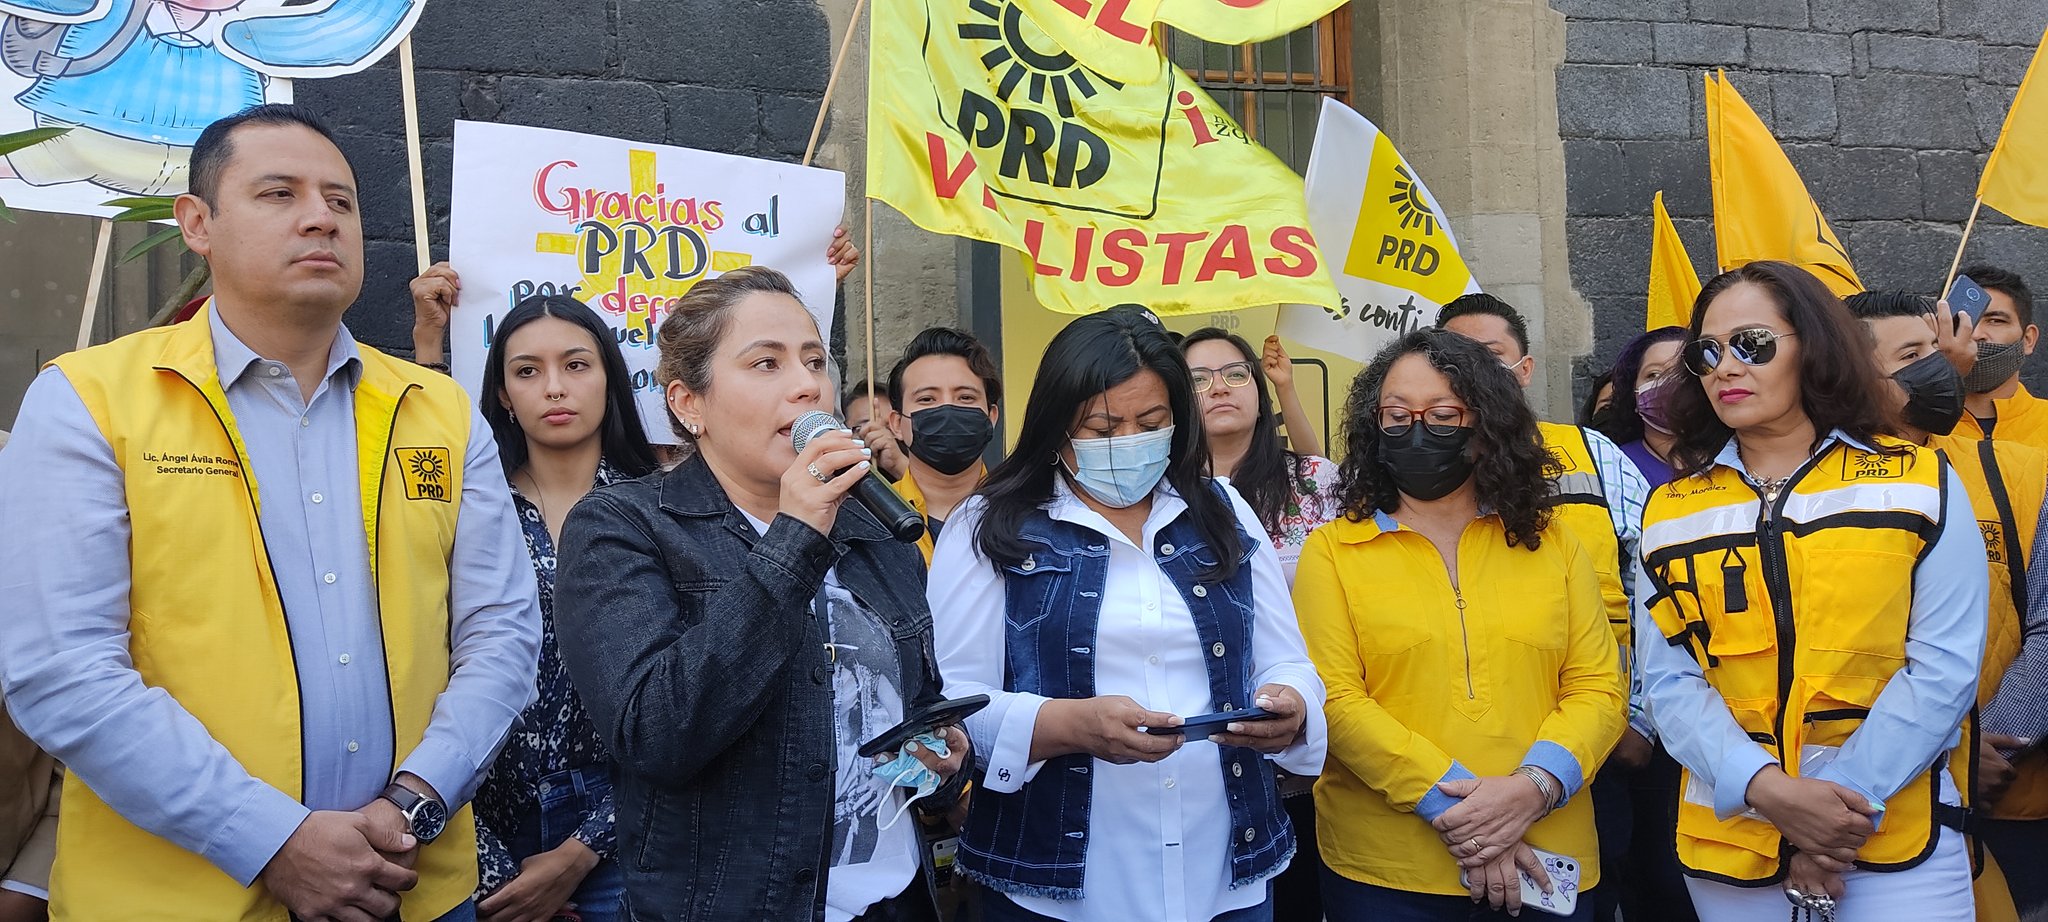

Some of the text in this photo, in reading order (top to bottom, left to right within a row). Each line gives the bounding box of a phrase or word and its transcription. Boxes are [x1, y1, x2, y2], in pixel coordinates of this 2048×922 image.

[956, 88, 1111, 190] PRD
[534, 160, 779, 237] Gracias al
[579, 220, 709, 281] PRD
[1376, 234, 1440, 277] PRD
[600, 276, 682, 325] defe
[1359, 295, 1424, 340] conti
[1211, 314, 1241, 331] PRD
[143, 452, 159, 463] Lic.
[162, 452, 189, 463] Ángel
[191, 453, 214, 464] Ávila
[156, 465, 239, 478] Secretario General
[1855, 468, 1889, 478] PRD
[416, 483, 444, 499] PRD
